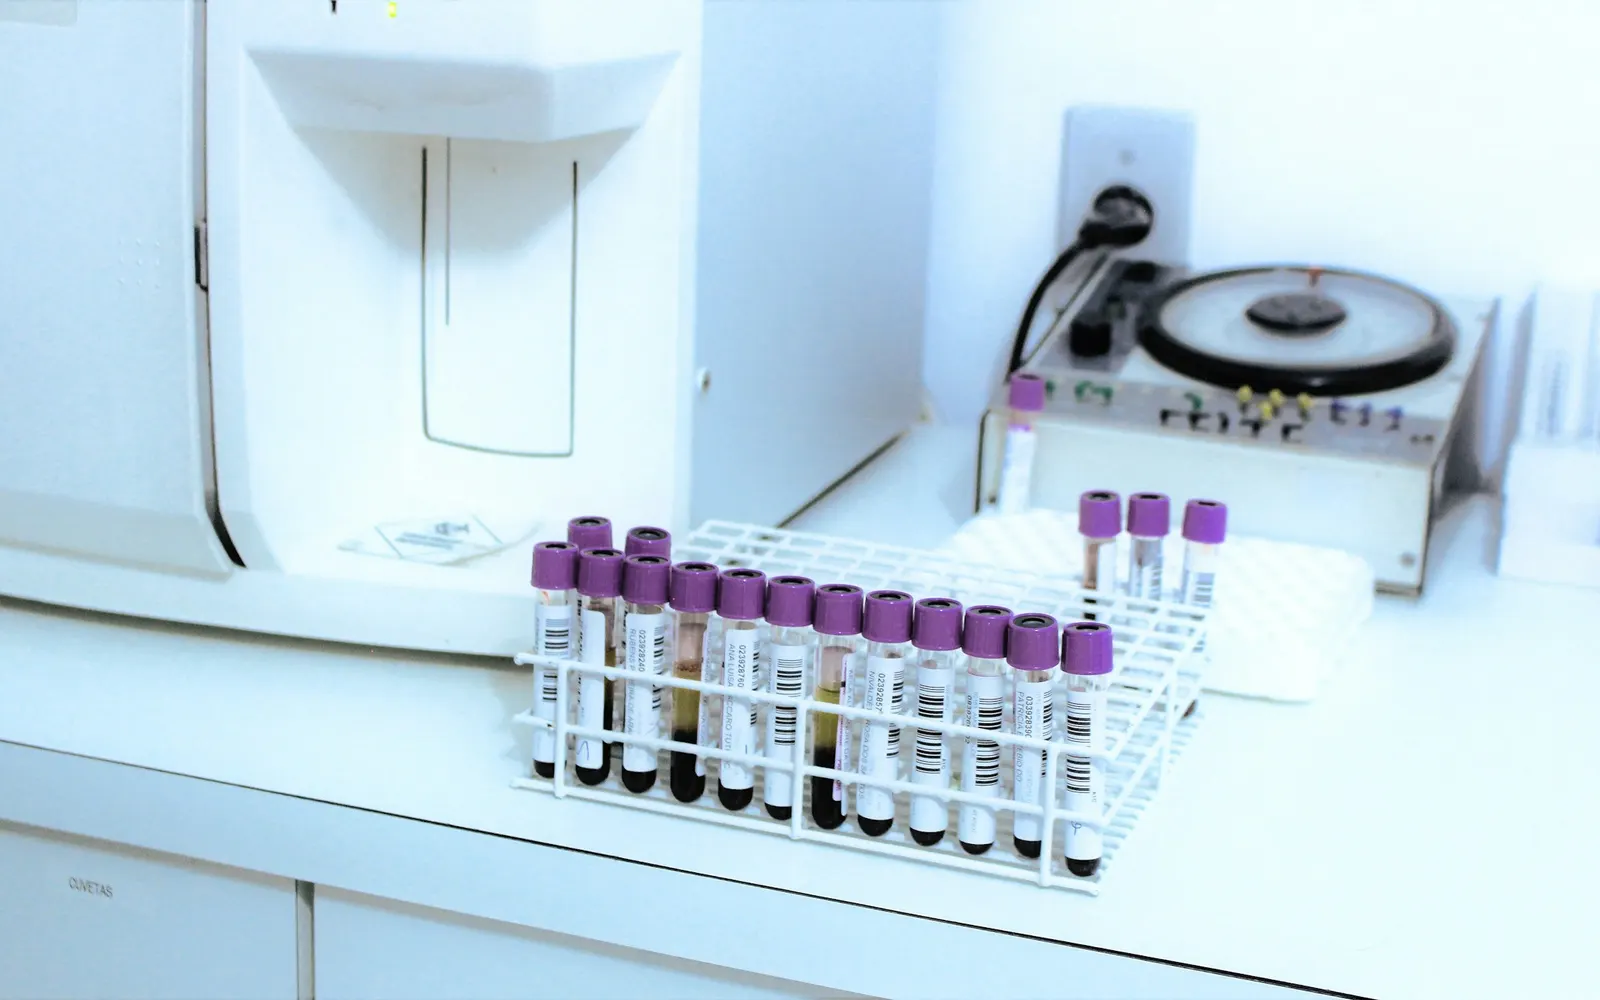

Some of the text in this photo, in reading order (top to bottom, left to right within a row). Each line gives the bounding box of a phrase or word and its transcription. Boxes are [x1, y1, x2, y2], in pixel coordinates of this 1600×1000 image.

[728, 643, 736, 661] ANA
[738, 644, 747, 687] 023928760
[727, 662, 735, 687] LUISA
[875, 673, 887, 713] 02392857
[1016, 691, 1026, 730] PATRICIA
[69, 876, 114, 899] CUVETAS
